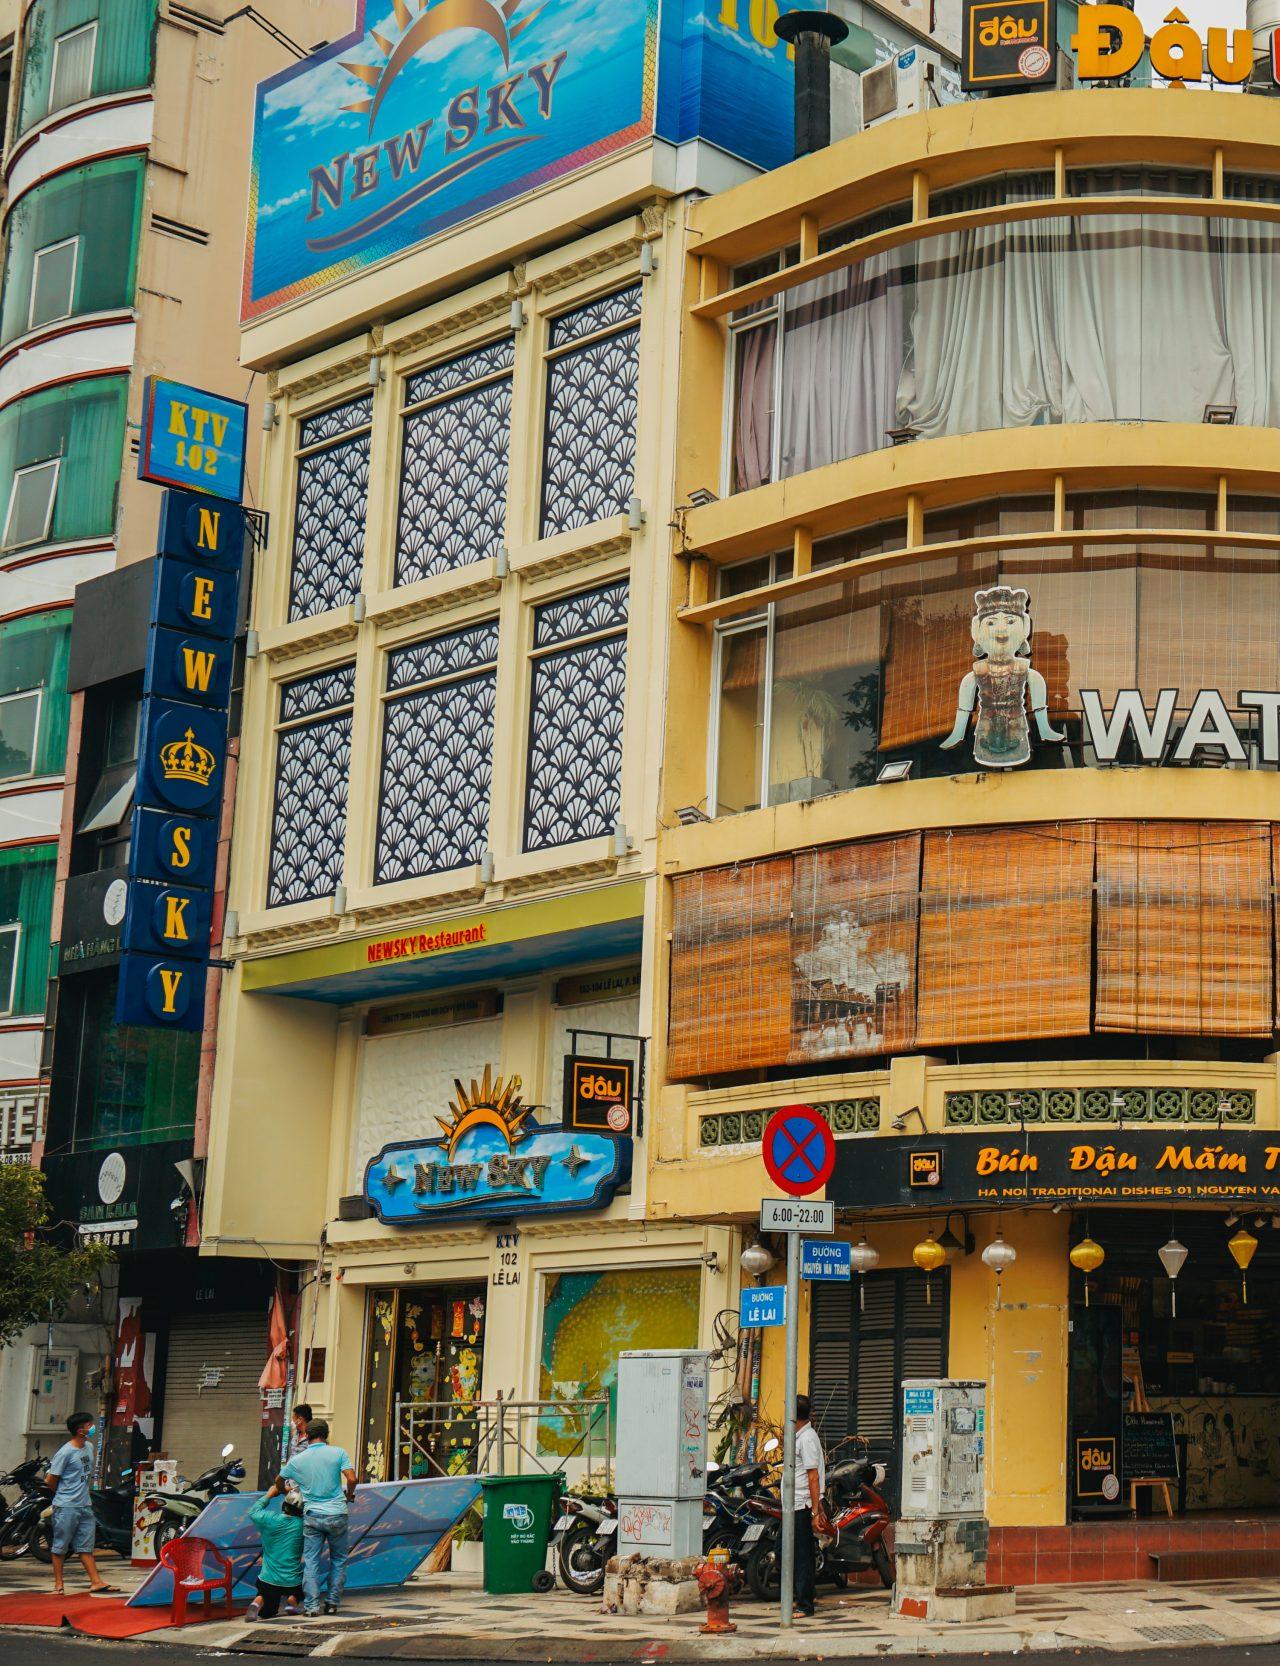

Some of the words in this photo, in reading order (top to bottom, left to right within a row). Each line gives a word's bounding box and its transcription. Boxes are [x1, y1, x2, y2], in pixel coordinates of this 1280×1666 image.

[306, 118, 434, 222] NEW
[444, 50, 568, 156] SKY
[168, 400, 230, 448] KTV
[175, 441, 218, 476] 102
[182, 508, 221, 692] NEW
[160, 826, 191, 1013] SKY
[368, 935, 418, 962] NEWSKY
[419, 922, 486, 951] Restaurant
[976, 1147, 1039, 1176] Bún
[1069, 1145, 1137, 1177] Đậu
[1155, 1145, 1247, 1173] Mắm
[412, 1162, 483, 1194] NEW
[487, 1154, 552, 1191] SKY
[978, 1188, 998, 1197] HA
[1121, 1187, 1172, 1196] DISHES
[1177, 1186, 1192, 1195] 01
[1197, 1186, 1257, 1195] NGUYEN
[772, 1208, 824, 1223] 6:00-22:00
[496, 1233, 520, 1248] KTV
[812, 1245, 841, 1257] ĐƯỜNG
[501, 1253, 517, 1265] 102
[493, 1269, 504, 1285] LÊ
[506, 1272, 521, 1285] LAI
[752, 1291, 773, 1303] ĐƯỜNG
[748, 1307, 760, 1321] LÊ
[762, 1308, 776, 1321] LAI
